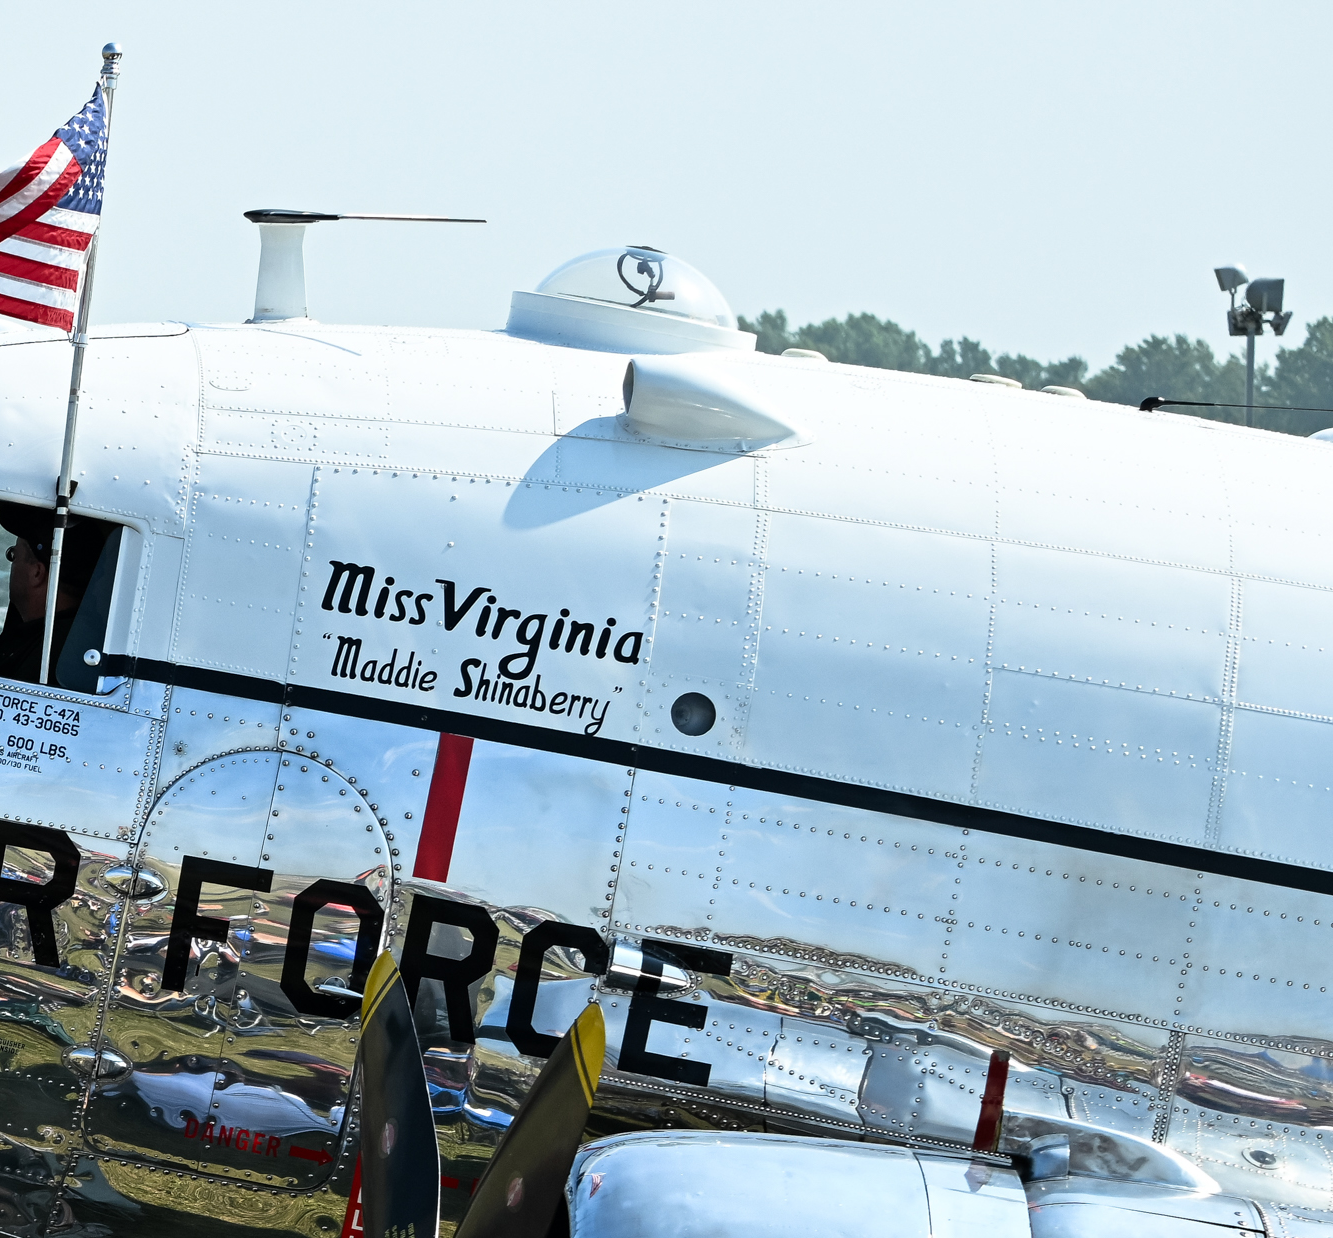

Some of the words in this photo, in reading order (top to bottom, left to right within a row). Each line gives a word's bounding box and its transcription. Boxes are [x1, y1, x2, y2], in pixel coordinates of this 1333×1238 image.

[321, 560, 434, 626] Miss
[435, 578, 644, 681] Virginia
[12, 713, 80, 737] 43-30665
[44, 705, 80, 723] C-47A
[6, 751, 39, 764] AIRCRAFT
[7, 735, 34, 751] 600
[40, 742, 69, 760] LBS.
[24, 764, 42, 773] FUEL
[161, 854, 733, 1087] FORCE
[184, 1117, 281, 1157] DANGER
